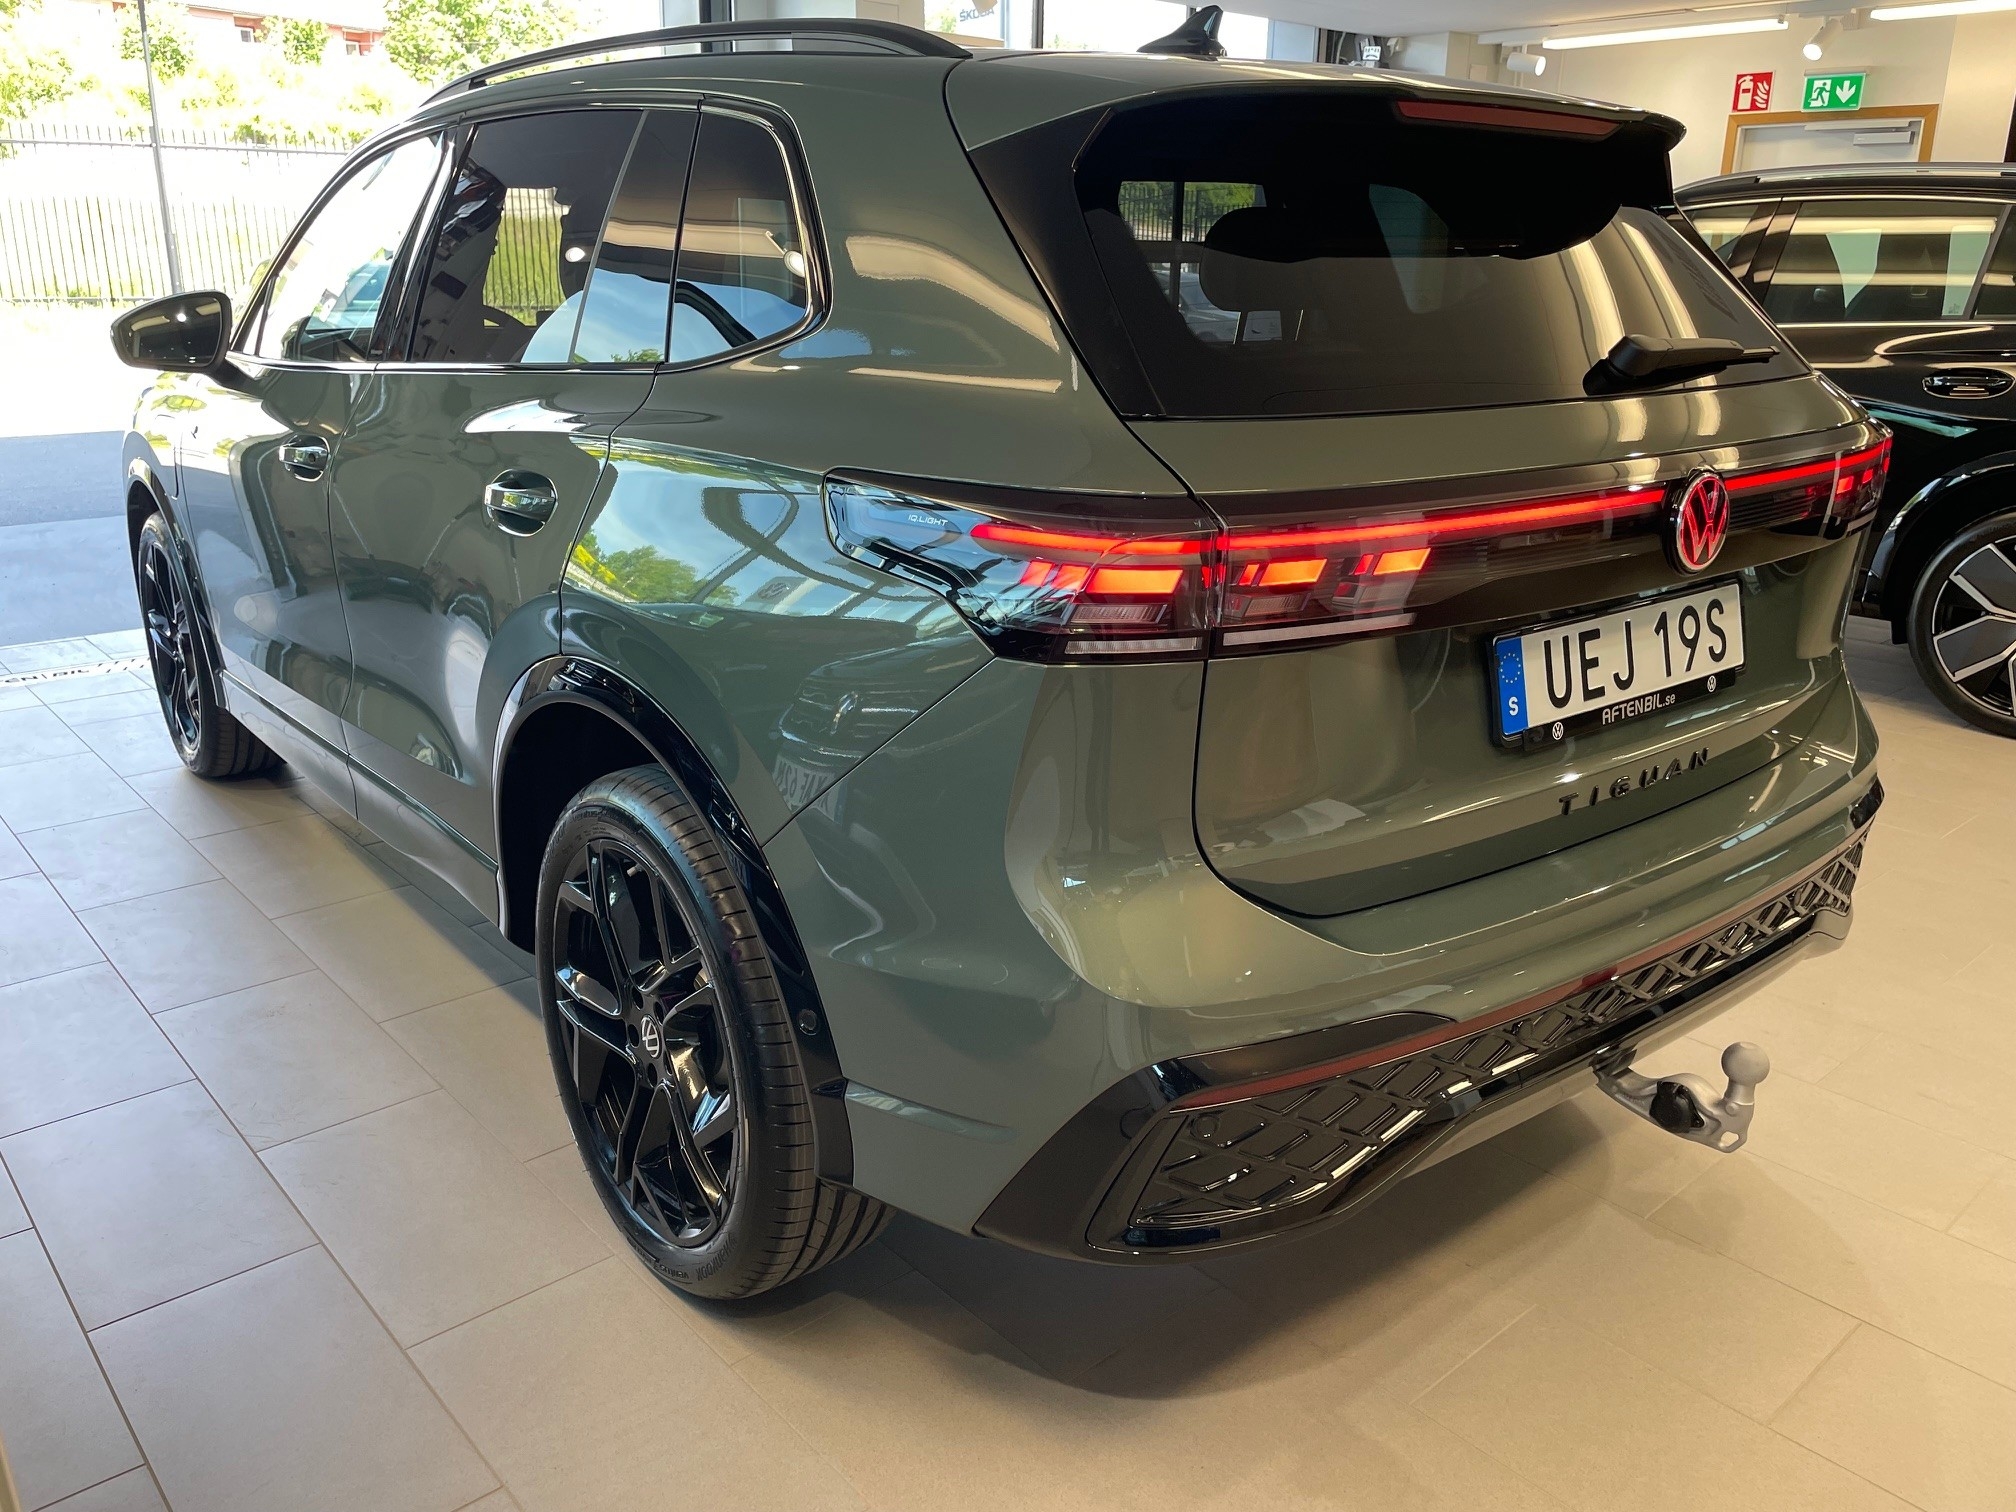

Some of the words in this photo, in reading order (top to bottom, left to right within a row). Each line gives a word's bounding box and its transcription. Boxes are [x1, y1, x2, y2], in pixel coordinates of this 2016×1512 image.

[908, 514, 948, 527] IQ.LIGHT
[1543, 620, 1635, 709] UEJ
[1653, 598, 1727, 678] 19S
[1508, 696, 1519, 716] S
[1602, 692, 1676, 725] AFTENBIL.se
[1558, 746, 1710, 816] TIGUAN
